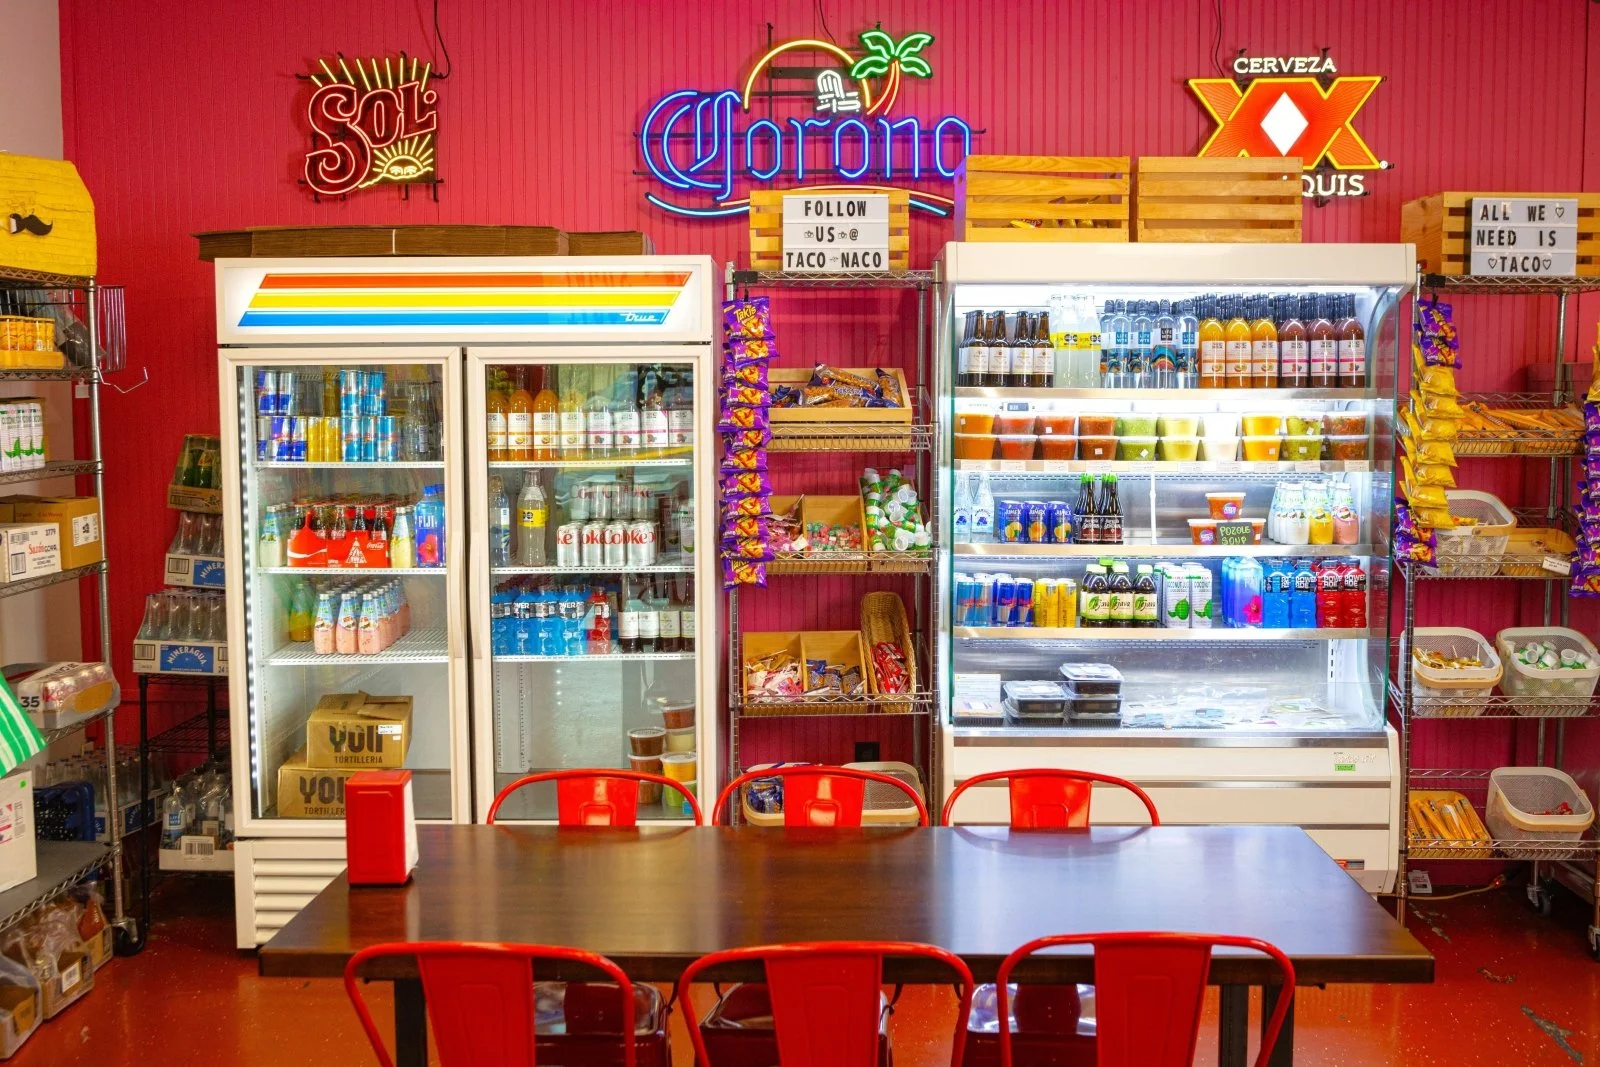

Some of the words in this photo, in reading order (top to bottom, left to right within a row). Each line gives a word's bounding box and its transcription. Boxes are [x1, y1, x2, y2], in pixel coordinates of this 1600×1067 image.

[1233, 56, 1337, 74] CERVEZA
[1301, 173, 1365, 197] QUIS
[804, 200, 867, 217] FOLLOW
[1480, 204, 1510, 221] ALL
[1527, 204, 1546, 222] WE
[815, 226, 835, 243] US
[1476, 230, 1517, 247] NEED
[1539, 230, 1557, 247] IS
[786, 252, 826, 268] TACO
[841, 252, 882, 268] NACO
[1499, 256, 1541, 273] TACO
[418, 515, 435, 528] FIJI
[1219, 526, 1251, 536] POZOLE
[1221, 536, 1247, 545] SOUP
[167, 646, 207, 664] MINERAGUA
[20, 696, 40, 708] 35
[334, 755, 383, 764] TORTILLERIA
